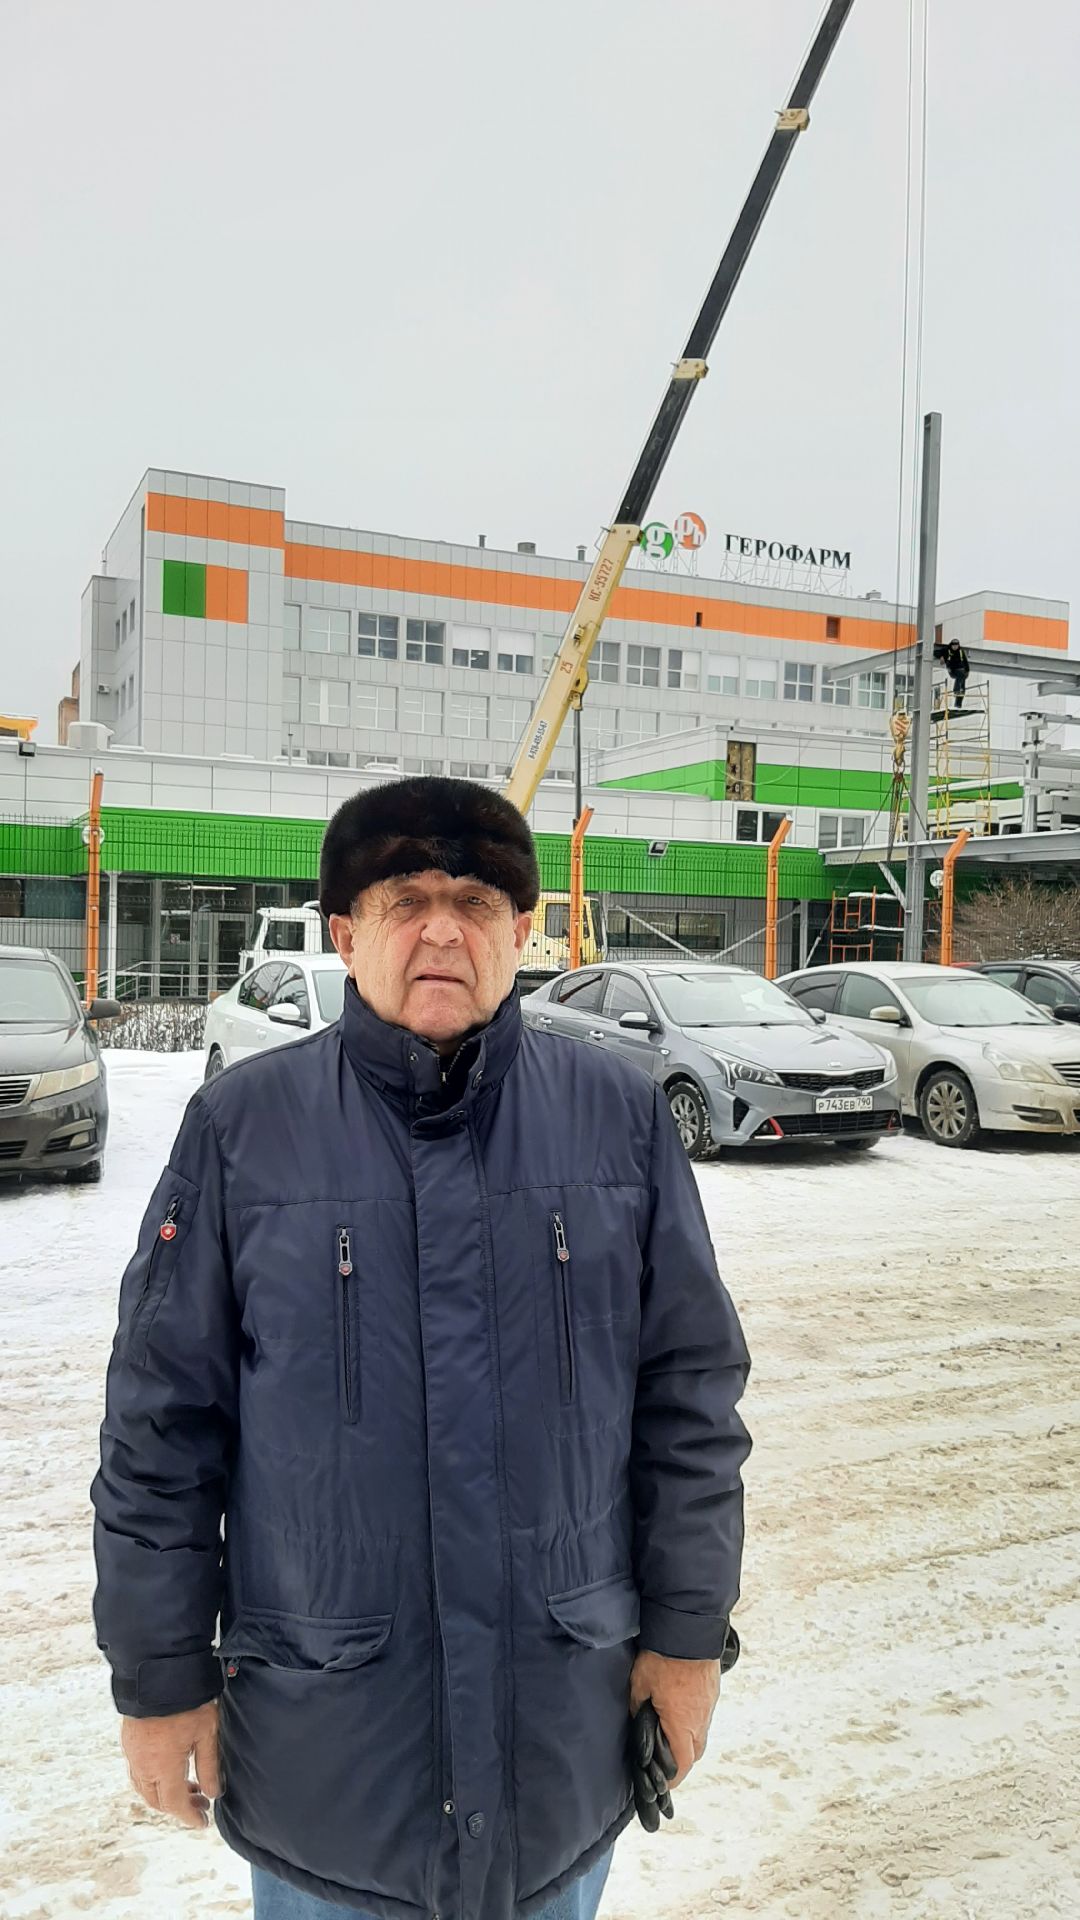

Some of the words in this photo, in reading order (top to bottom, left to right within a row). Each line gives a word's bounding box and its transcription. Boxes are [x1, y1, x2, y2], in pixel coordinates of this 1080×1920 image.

[724, 533, 851, 570] ГЕРОФАРМ
[588, 558, 614, 602] КС-55727
[560, 661, 573, 674] 25
